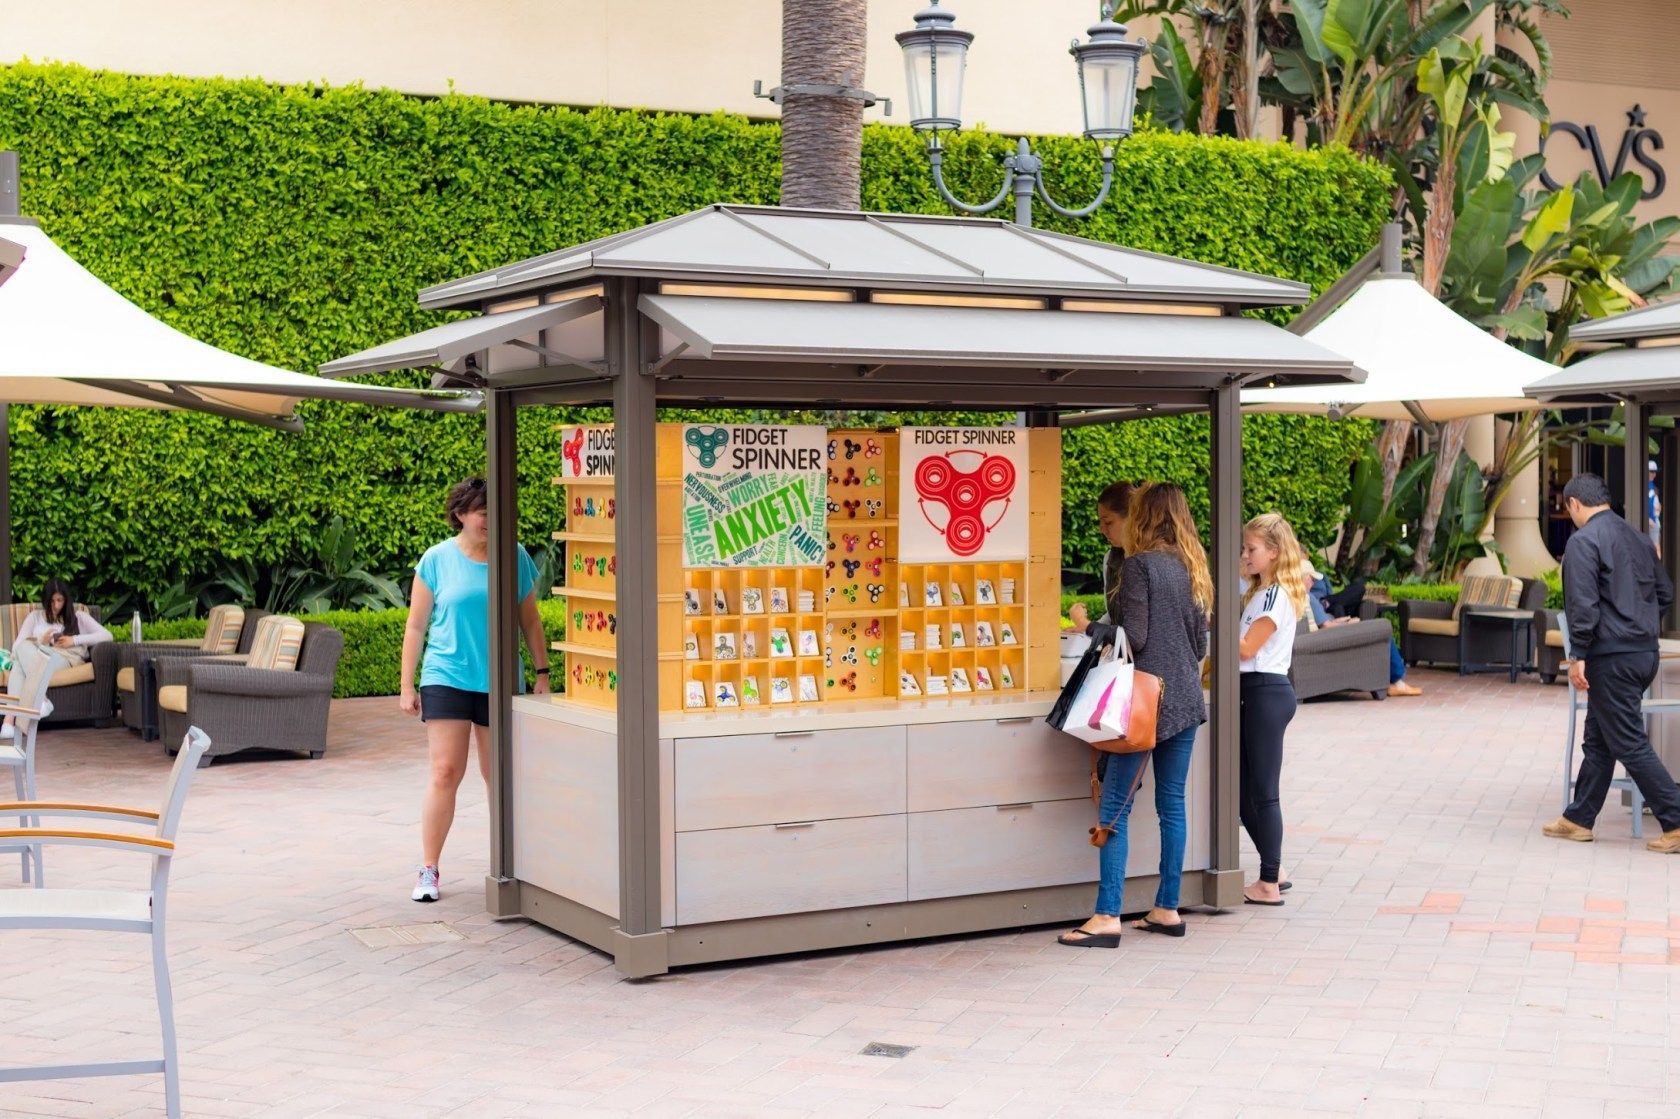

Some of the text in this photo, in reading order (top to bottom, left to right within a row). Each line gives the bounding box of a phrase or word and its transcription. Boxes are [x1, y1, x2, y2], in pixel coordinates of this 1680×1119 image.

[1539, 121, 1667, 200] CVS
[588, 429, 614, 450] FIDGE
[733, 428, 788, 445] FIDGET
[915, 430, 1016, 445] FIDGET SPINNER
[586, 455, 614, 476] SPIN
[732, 448, 821, 470] SPINNER
[684, 473, 726, 514] NERVOUSNESS
[718, 472, 753, 493] OVERWHELMING
[727, 474, 771, 508] WORRY
[768, 472, 779, 490] FEAR
[713, 478, 812, 560] ANXIETY
[812, 497, 826, 531] FEELING
[686, 503, 716, 564] UNEASE
[789, 524, 823, 560] PANIC
[732, 546, 759, 565] SUPPORT
[759, 539, 776, 565] HEALTH
[776, 532, 788, 565] CONCERN
